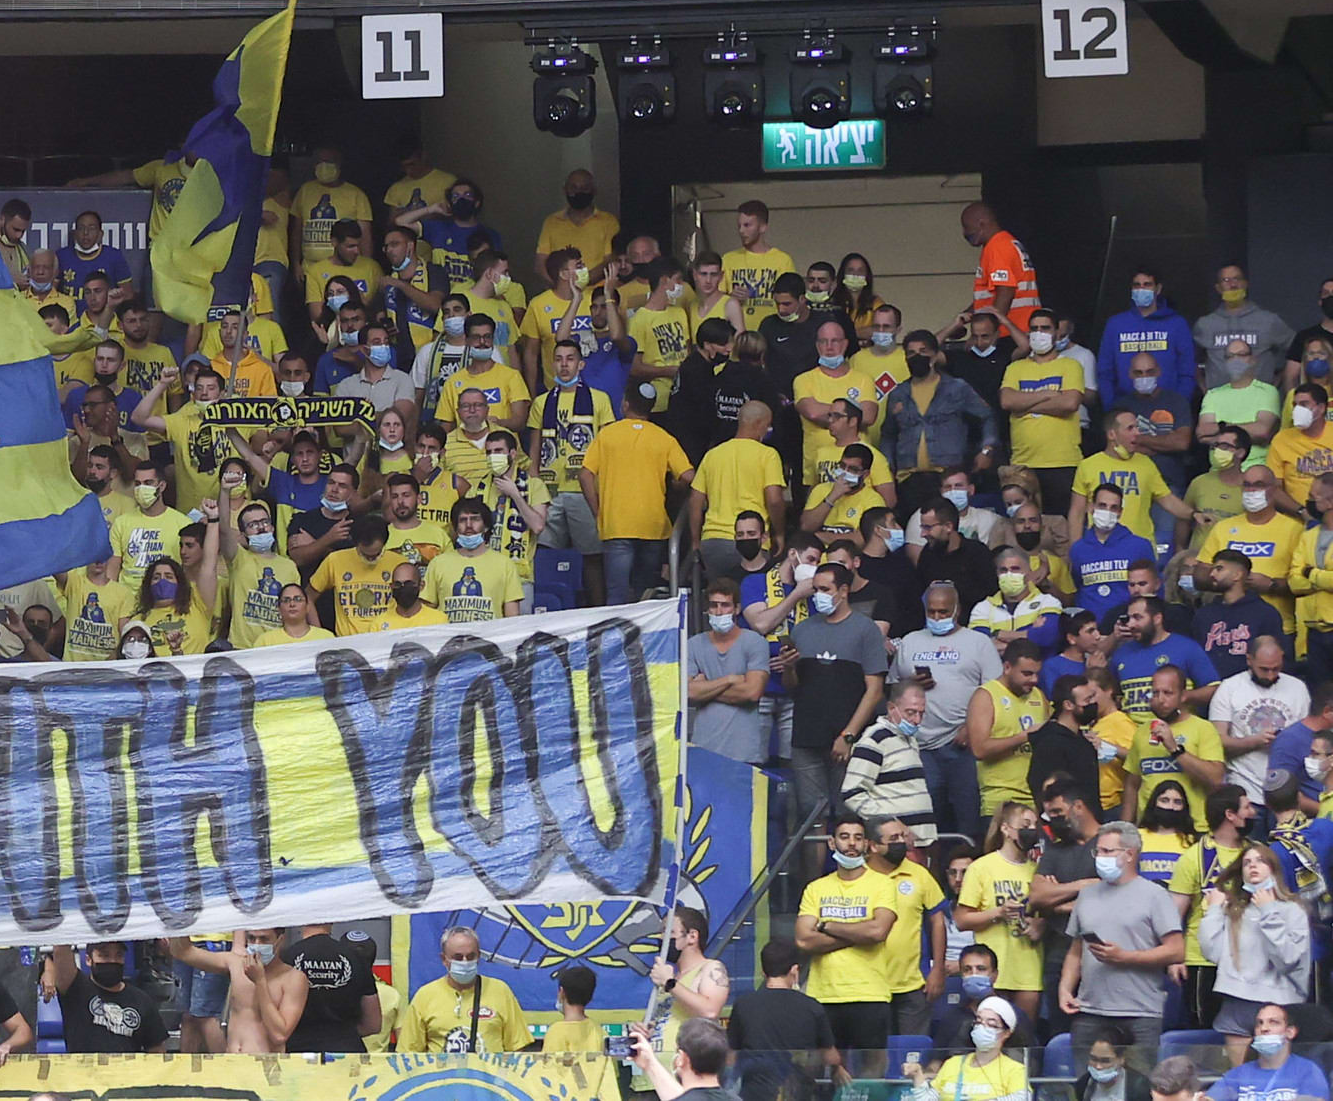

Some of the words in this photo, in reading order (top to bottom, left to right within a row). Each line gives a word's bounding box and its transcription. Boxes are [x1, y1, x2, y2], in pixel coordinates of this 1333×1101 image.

[1052, 8, 1118, 59] 12
[375, 31, 429, 81] 11
[805, 124, 874, 165] יציאה
[1154, 331, 1168, 340] TLV
[205, 402, 271, 419] האחרונ
[299, 400, 354, 418] השנייה
[1080, 561, 1112, 572] MACCABI
[1113, 560, 1129, 569] TLV
[1083, 569, 1128, 582] BASKETBALL
[444, 595, 491, 609] MAXIMUM
[72, 620, 112, 636] MAXIMUM
[69, 632, 116, 649] MADNESS
[913, 651, 959, 661] ENGLAND
[320, 618, 663, 901] YOU
[1141, 760, 1177, 772] FOX
[820, 896, 852, 905] MACCABI
[853, 896, 868, 905] TLV
[304, 960, 342, 971] MAAYAN
[307, 970, 340, 980] Security
